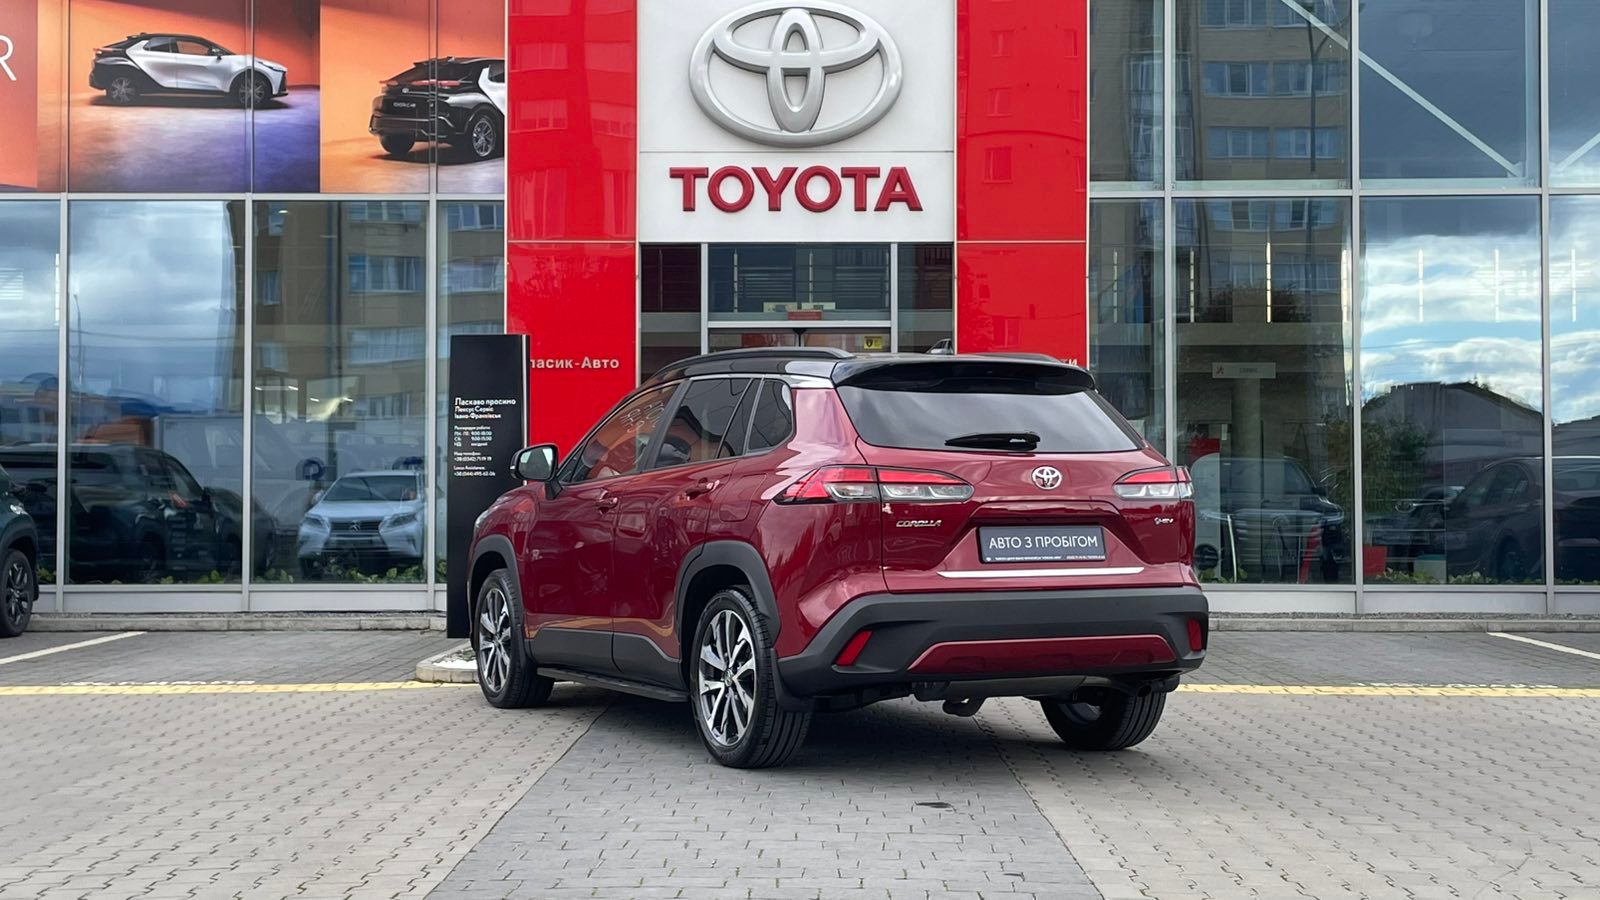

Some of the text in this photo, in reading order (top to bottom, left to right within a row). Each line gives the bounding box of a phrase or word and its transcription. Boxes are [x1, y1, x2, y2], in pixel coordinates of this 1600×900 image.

[669, 165, 923, 213] TOYOTA
[455, 397, 516, 407] Ласкаво просимо
[896, 519, 942, 528] COROLLA
[989, 536, 1022, 549] АВТО
[1035, 535, 1099, 548] ПРОБІГОМ
